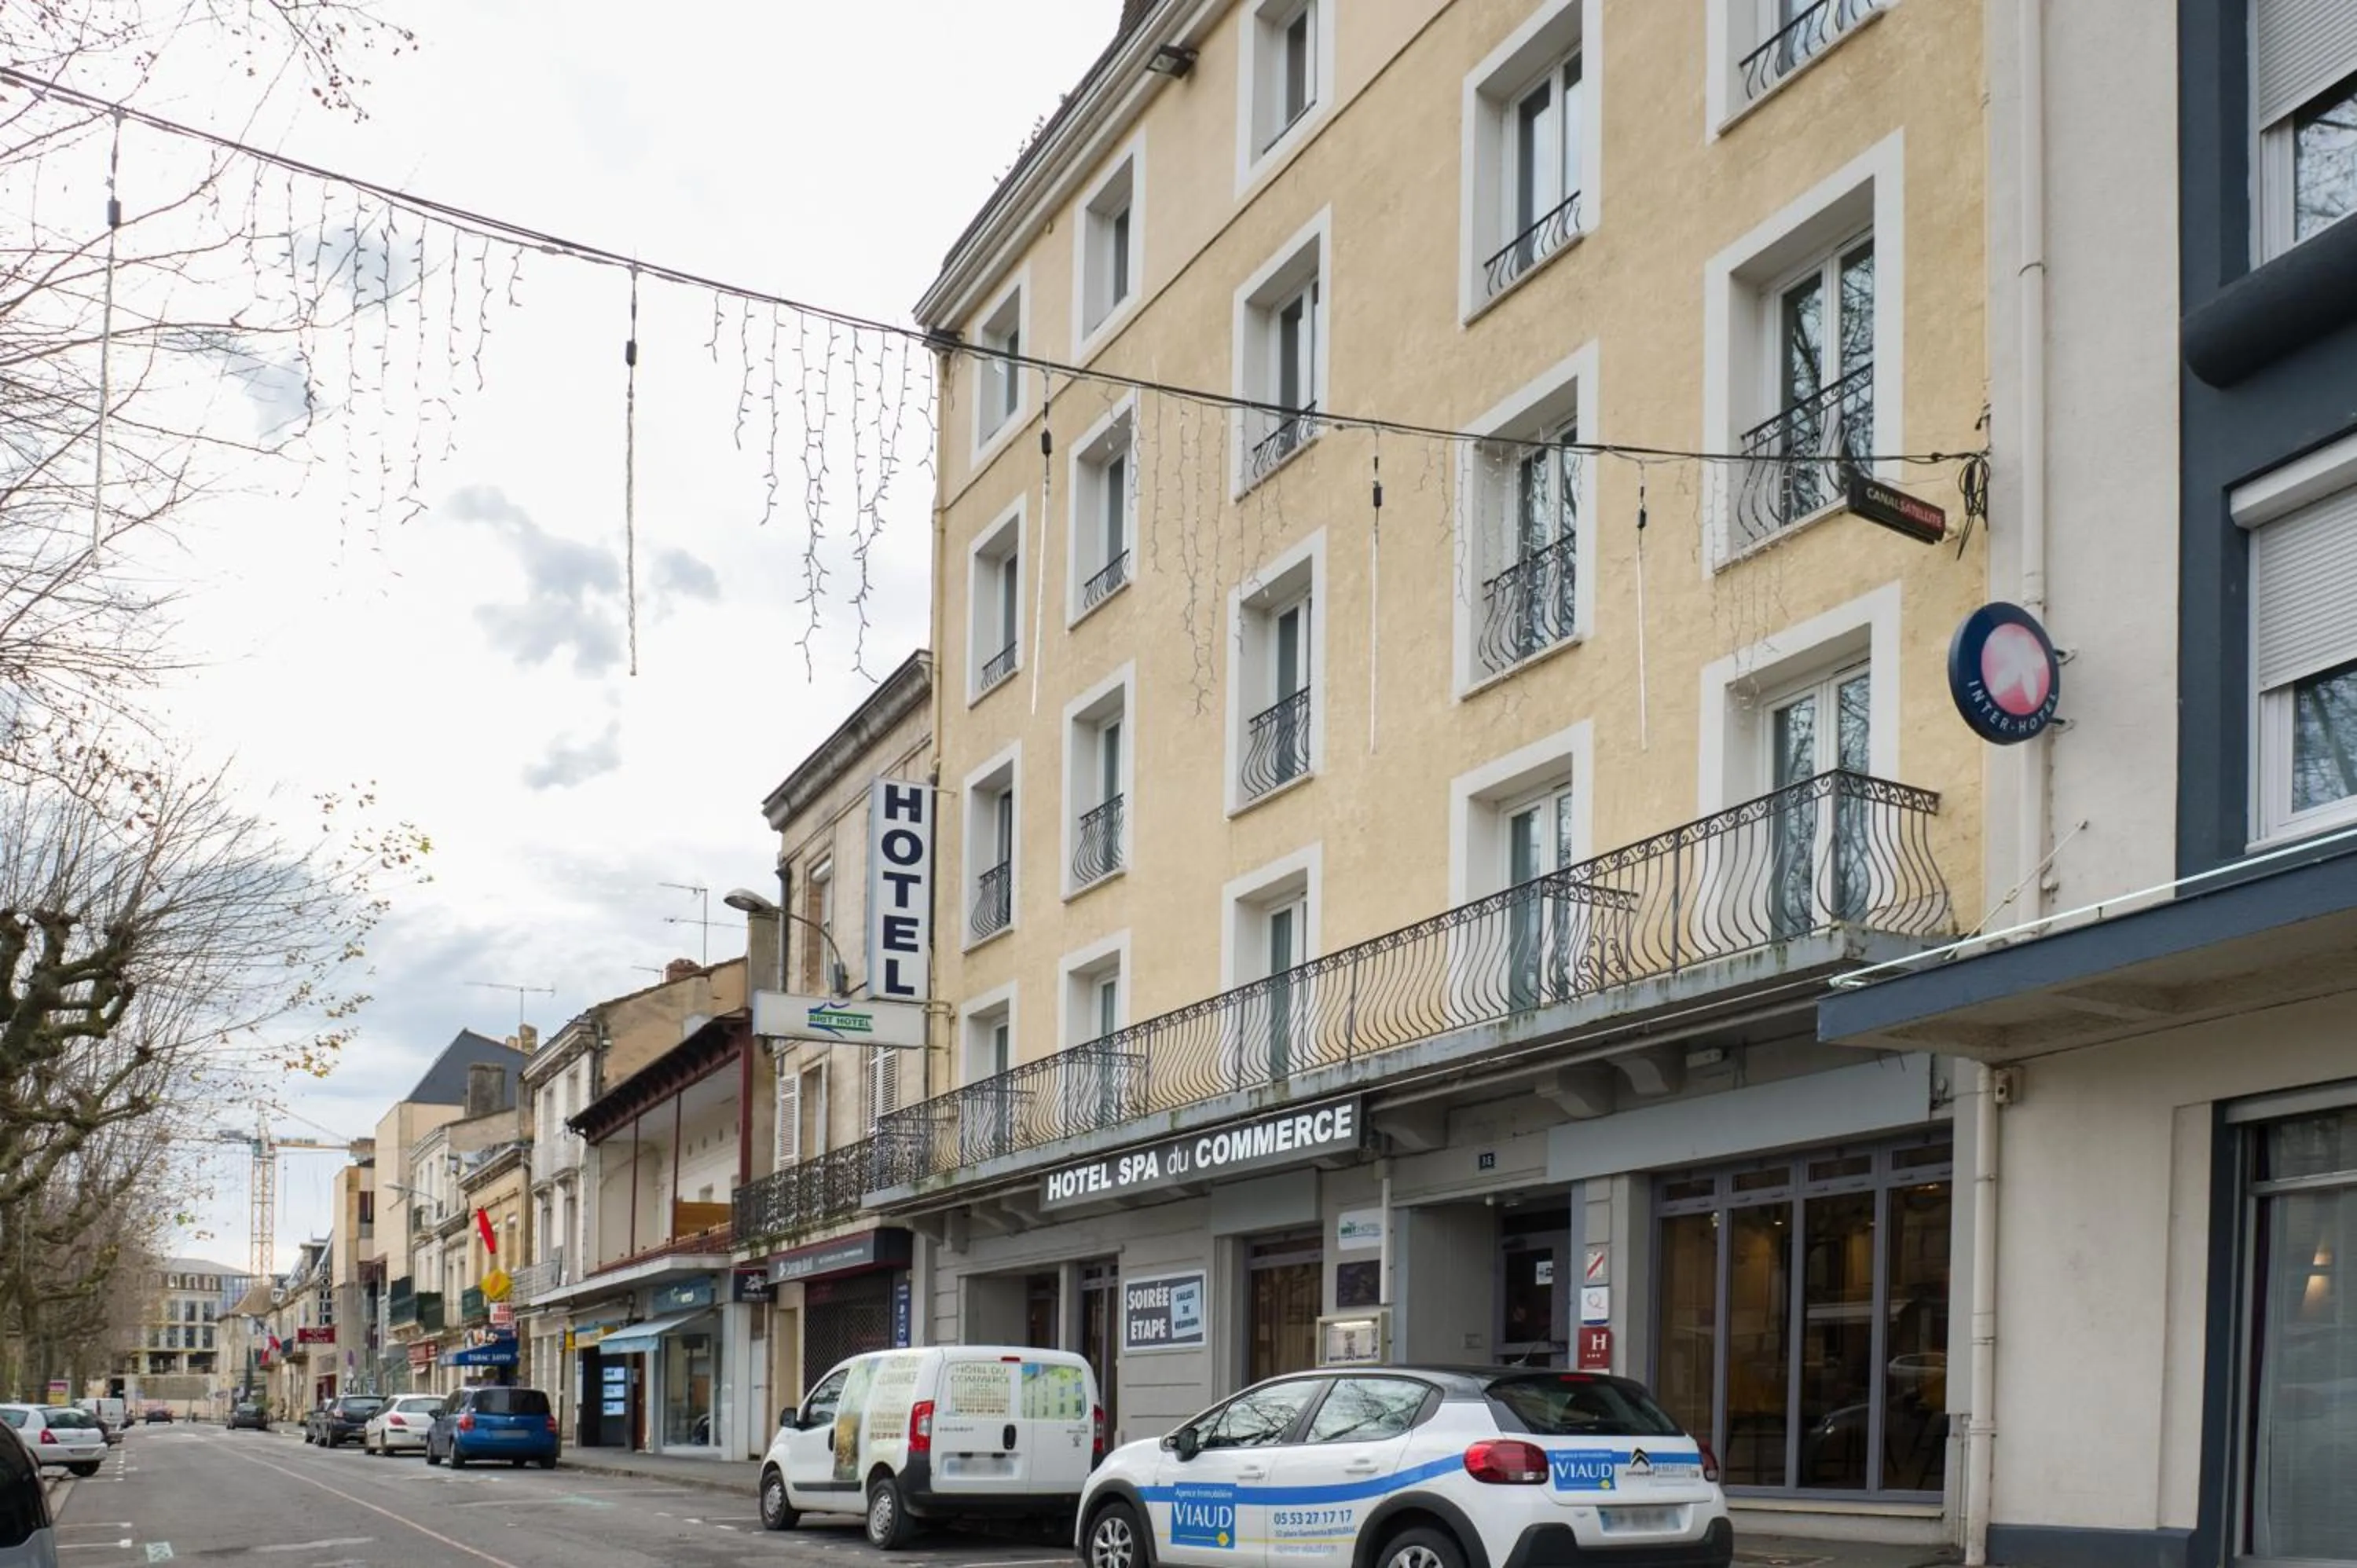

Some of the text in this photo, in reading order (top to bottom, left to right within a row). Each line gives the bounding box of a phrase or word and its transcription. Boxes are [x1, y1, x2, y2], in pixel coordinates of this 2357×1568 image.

[881, 784, 923, 996] HOTEL
[837, 1017, 869, 1027] HOTEL
[1047, 1105, 1352, 1200] HOTEL SPA du COMMERCE
[1127, 1282, 1170, 1310] SOIRÉE
[1131, 1316, 1167, 1340] ÉTAPE
[1592, 1333, 1607, 1350] H
[1555, 1461, 1613, 1479] VIAUD
[1173, 1501, 1233, 1529] VIAUD
[1274, 1509, 1352, 1525] 05 53 27 17 17
